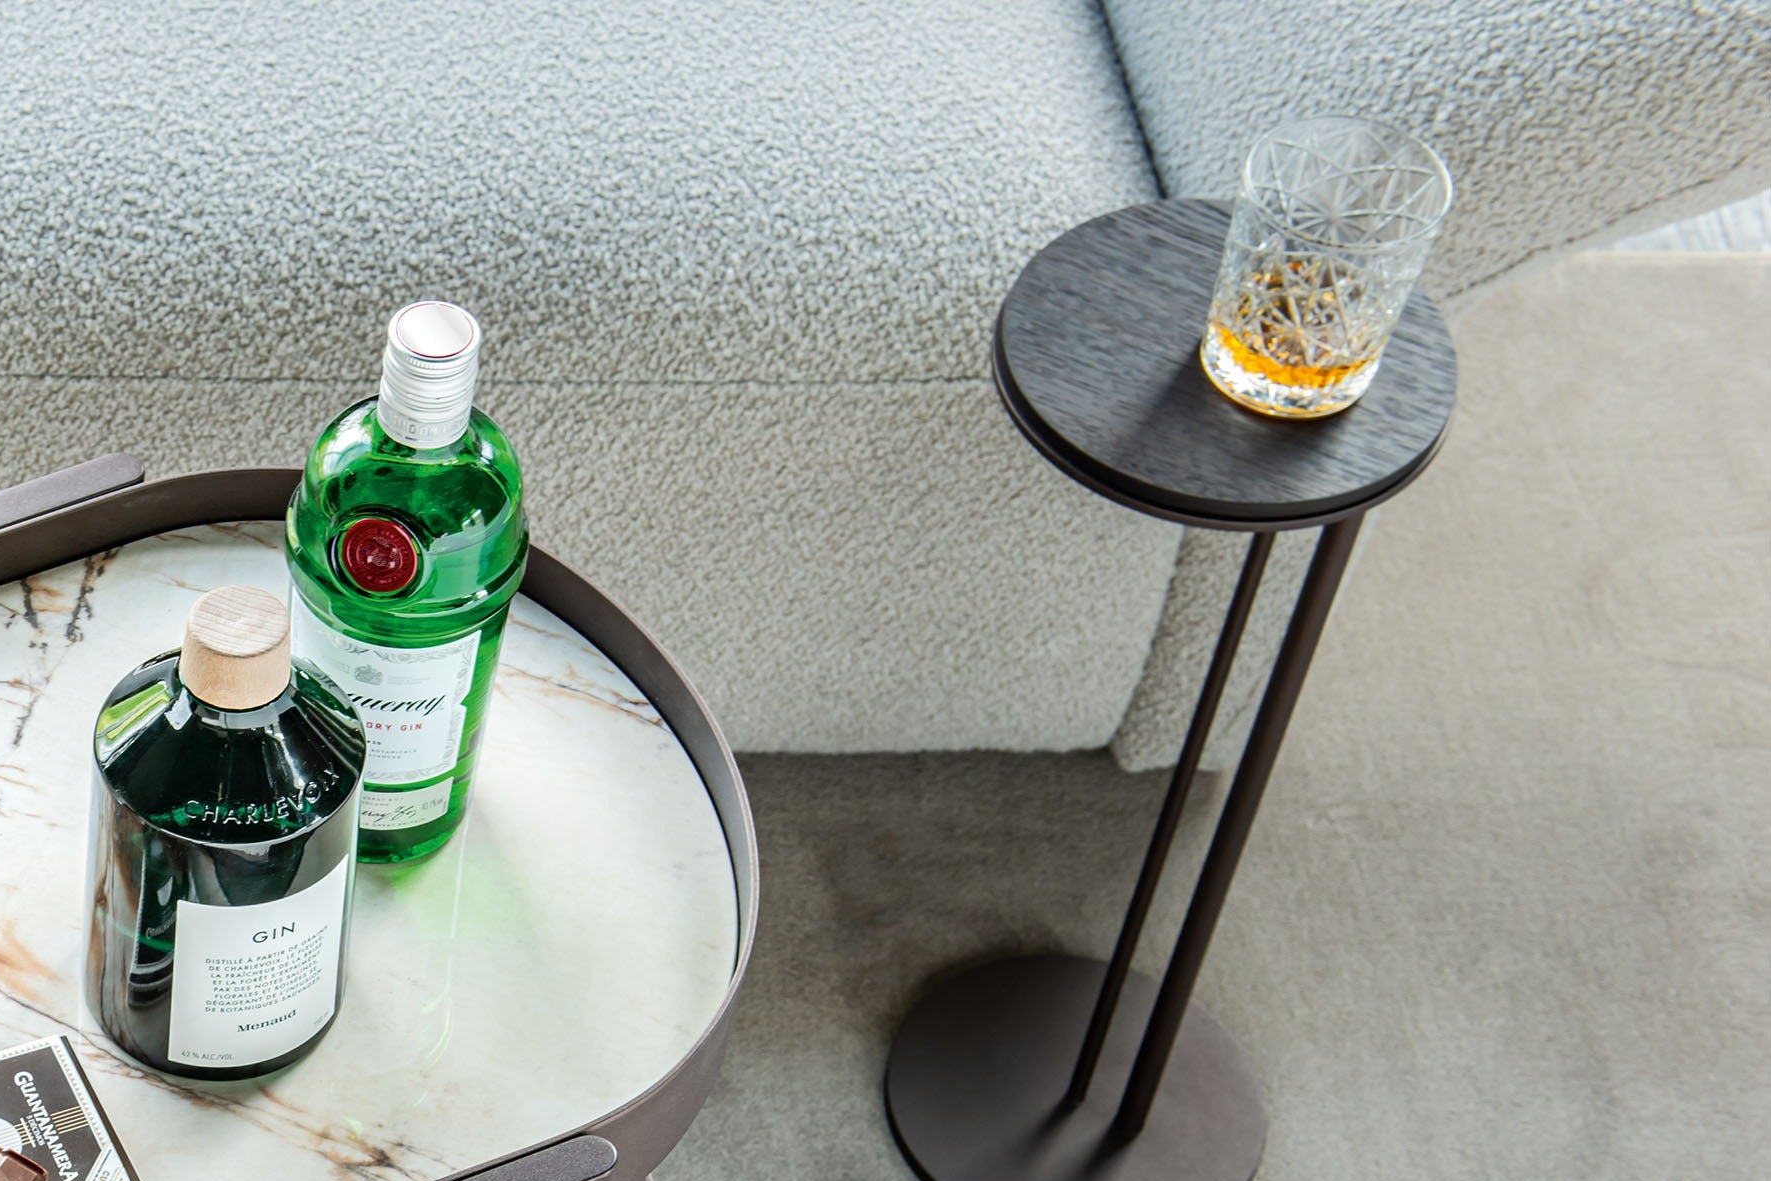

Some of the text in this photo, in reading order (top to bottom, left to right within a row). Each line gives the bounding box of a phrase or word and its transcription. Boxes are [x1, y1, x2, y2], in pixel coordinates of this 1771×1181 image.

[366, 721, 422, 732] DRY GIN
[185, 763, 339, 824] CHARLEVOIX
[252, 922, 296, 944] GIN
[205, 957, 243, 965] DISTILLÉ
[257, 949, 285, 962] PARTIR
[288, 944, 298, 952] DE
[215, 990, 259, 999] FLORALES
[266, 992, 276, 1000] DE
[236, 1009, 297, 1033] Menaud
